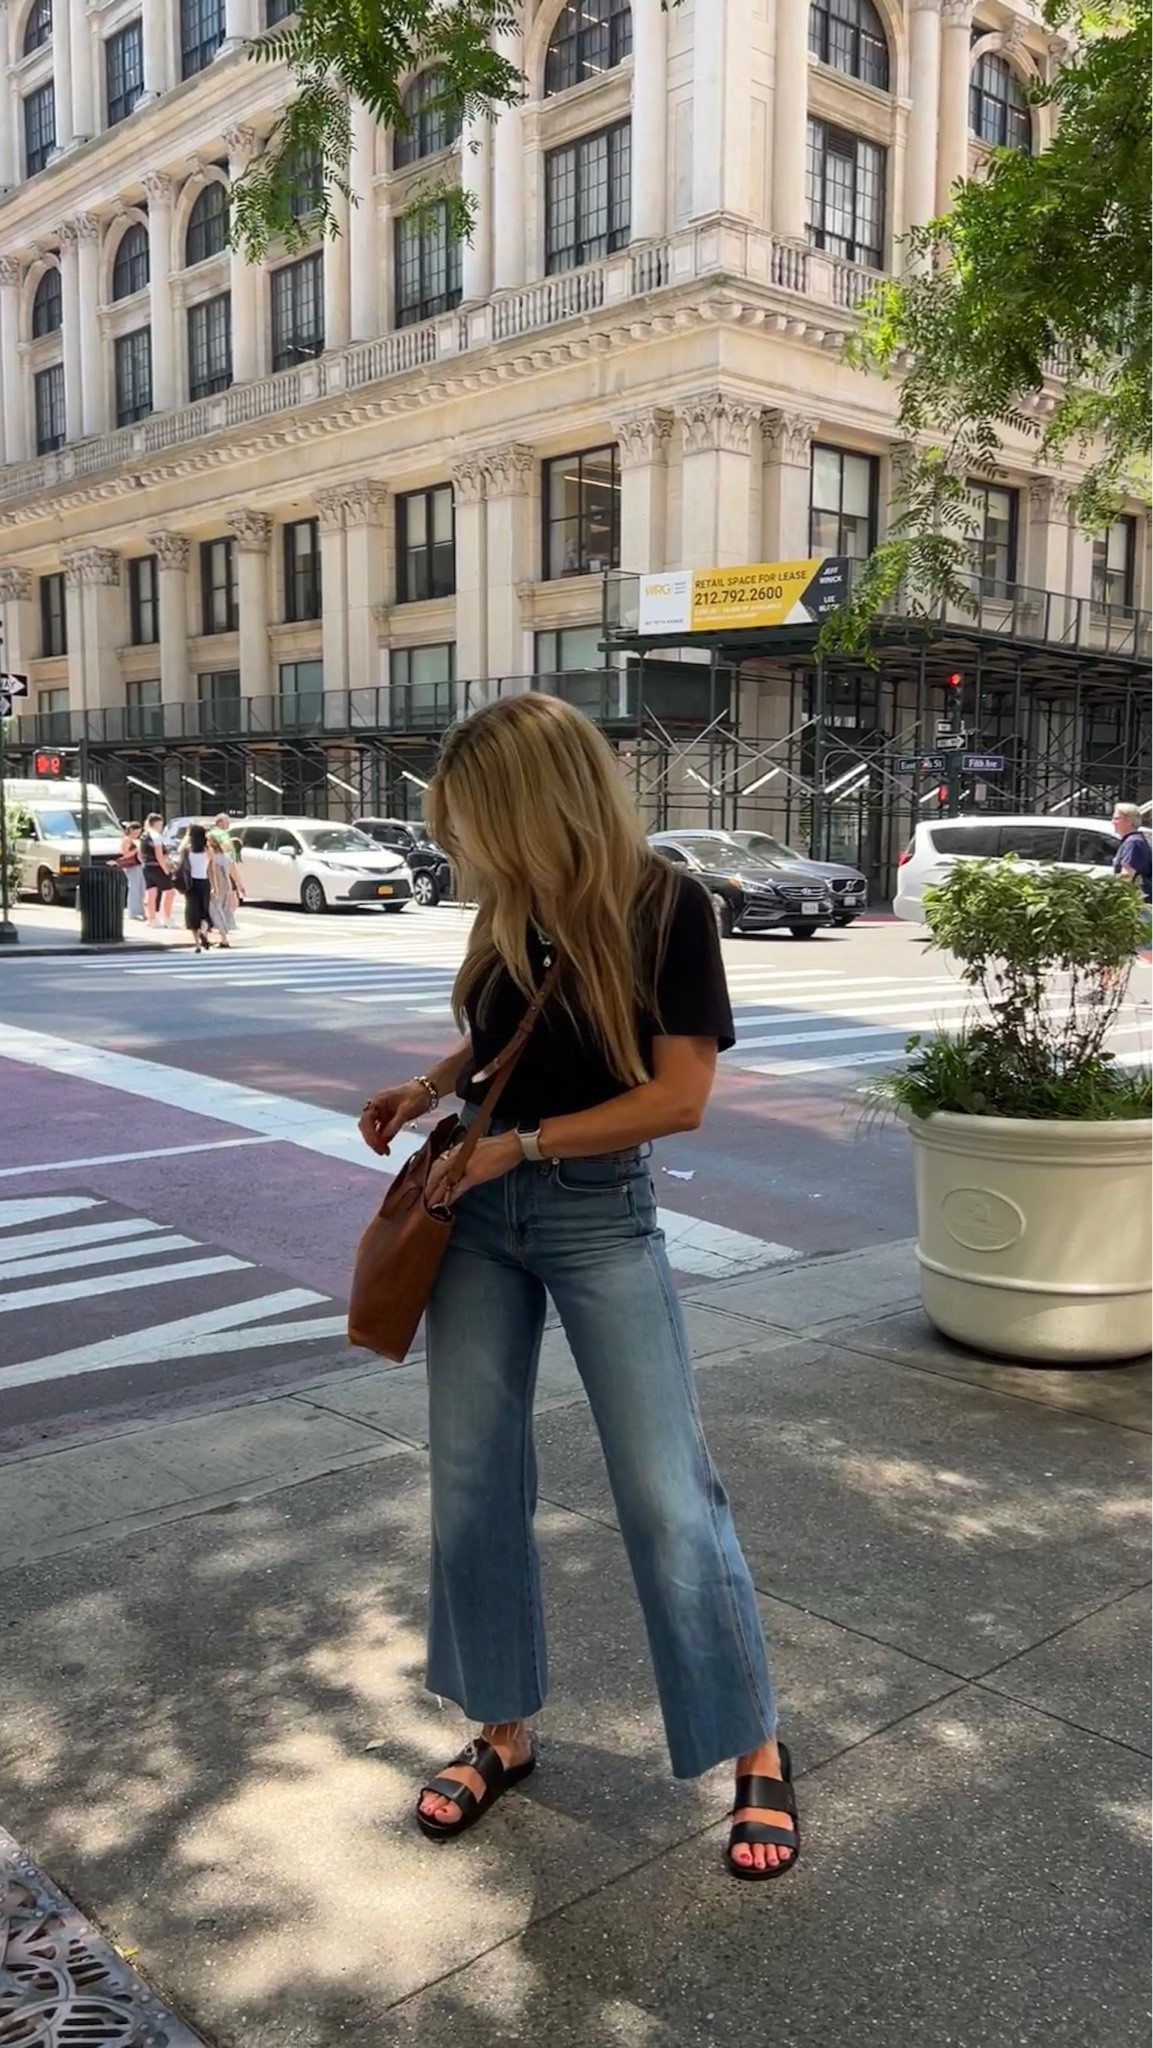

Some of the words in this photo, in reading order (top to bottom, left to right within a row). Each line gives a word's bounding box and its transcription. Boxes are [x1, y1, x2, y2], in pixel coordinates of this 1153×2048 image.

[695, 579, 724, 589] RETAIL
[727, 575, 757, 586] SPACE
[759, 573, 776, 583] FOR
[778, 570, 807, 581] LEASE
[645, 583, 671, 596] WRG
[694, 586, 783, 606] 212.792.2600
[968, 759, 984, 768] Fifth
[985, 760, 998, 768] Ave
